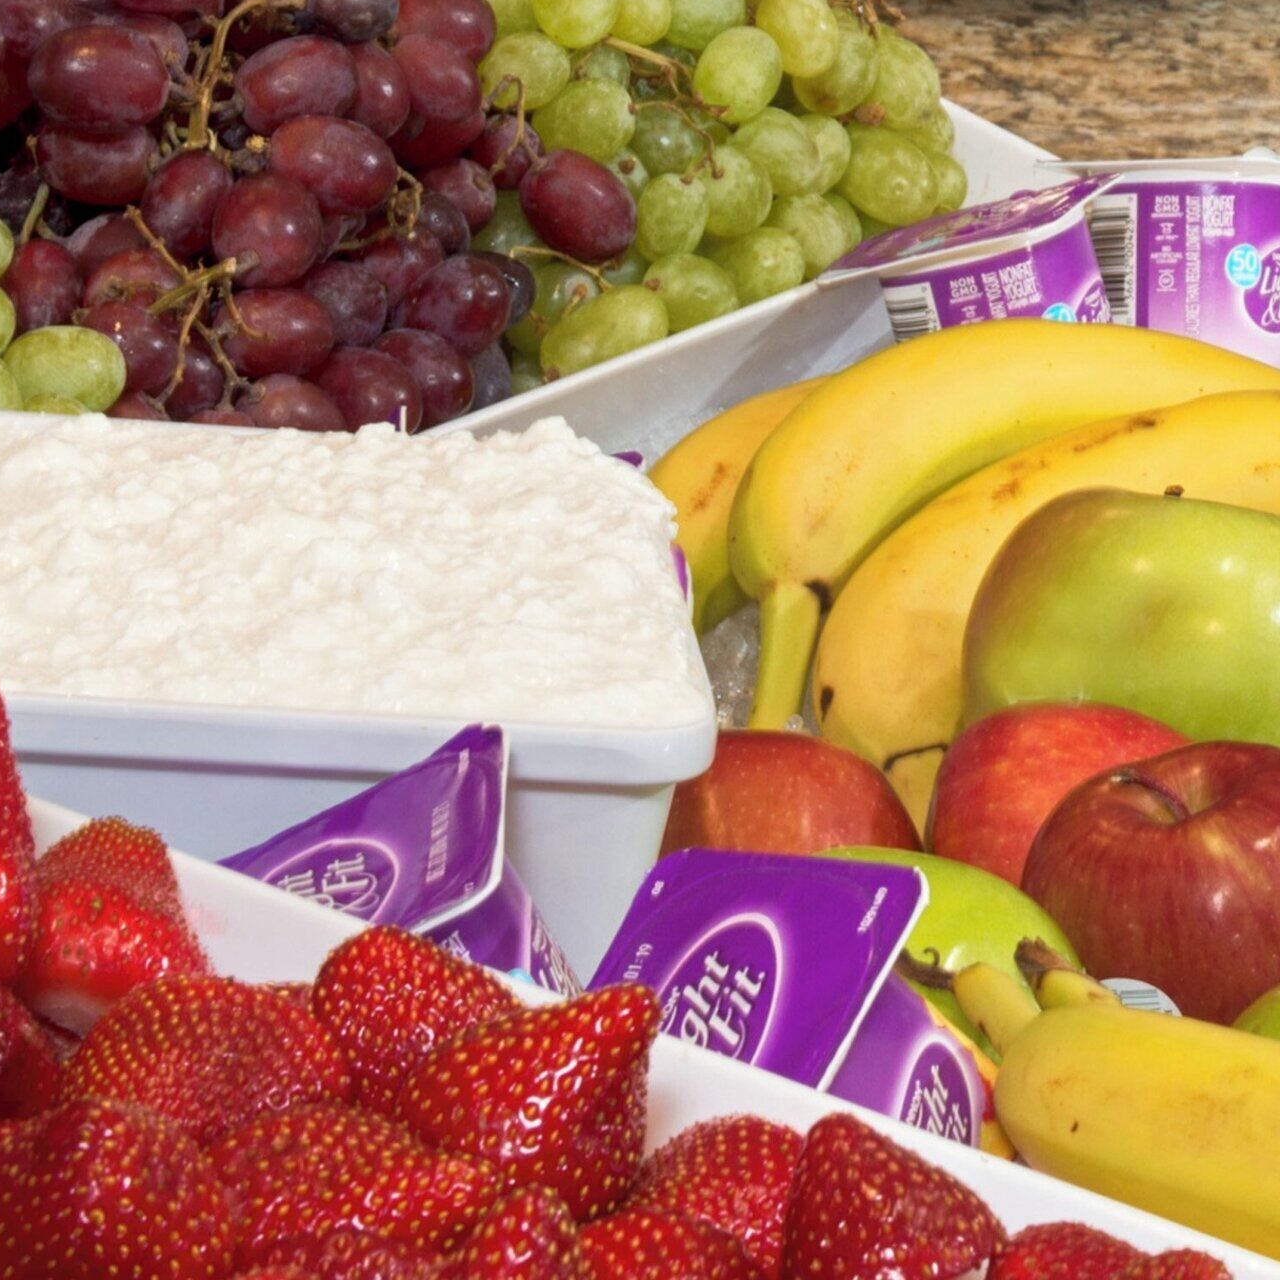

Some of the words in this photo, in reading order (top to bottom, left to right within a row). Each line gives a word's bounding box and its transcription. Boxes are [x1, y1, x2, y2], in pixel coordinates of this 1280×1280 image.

[1154, 204, 1181, 214] GMO
[1155, 195, 1179, 205] NON
[1232, 249, 1258, 272] 50
[998, 259, 1034, 284] NONFAT
[949, 276, 976, 289] NON
[951, 284, 979, 298] GMO
[1002, 276, 1038, 302] YOGURT
[681, 950, 730, 1050] ght
